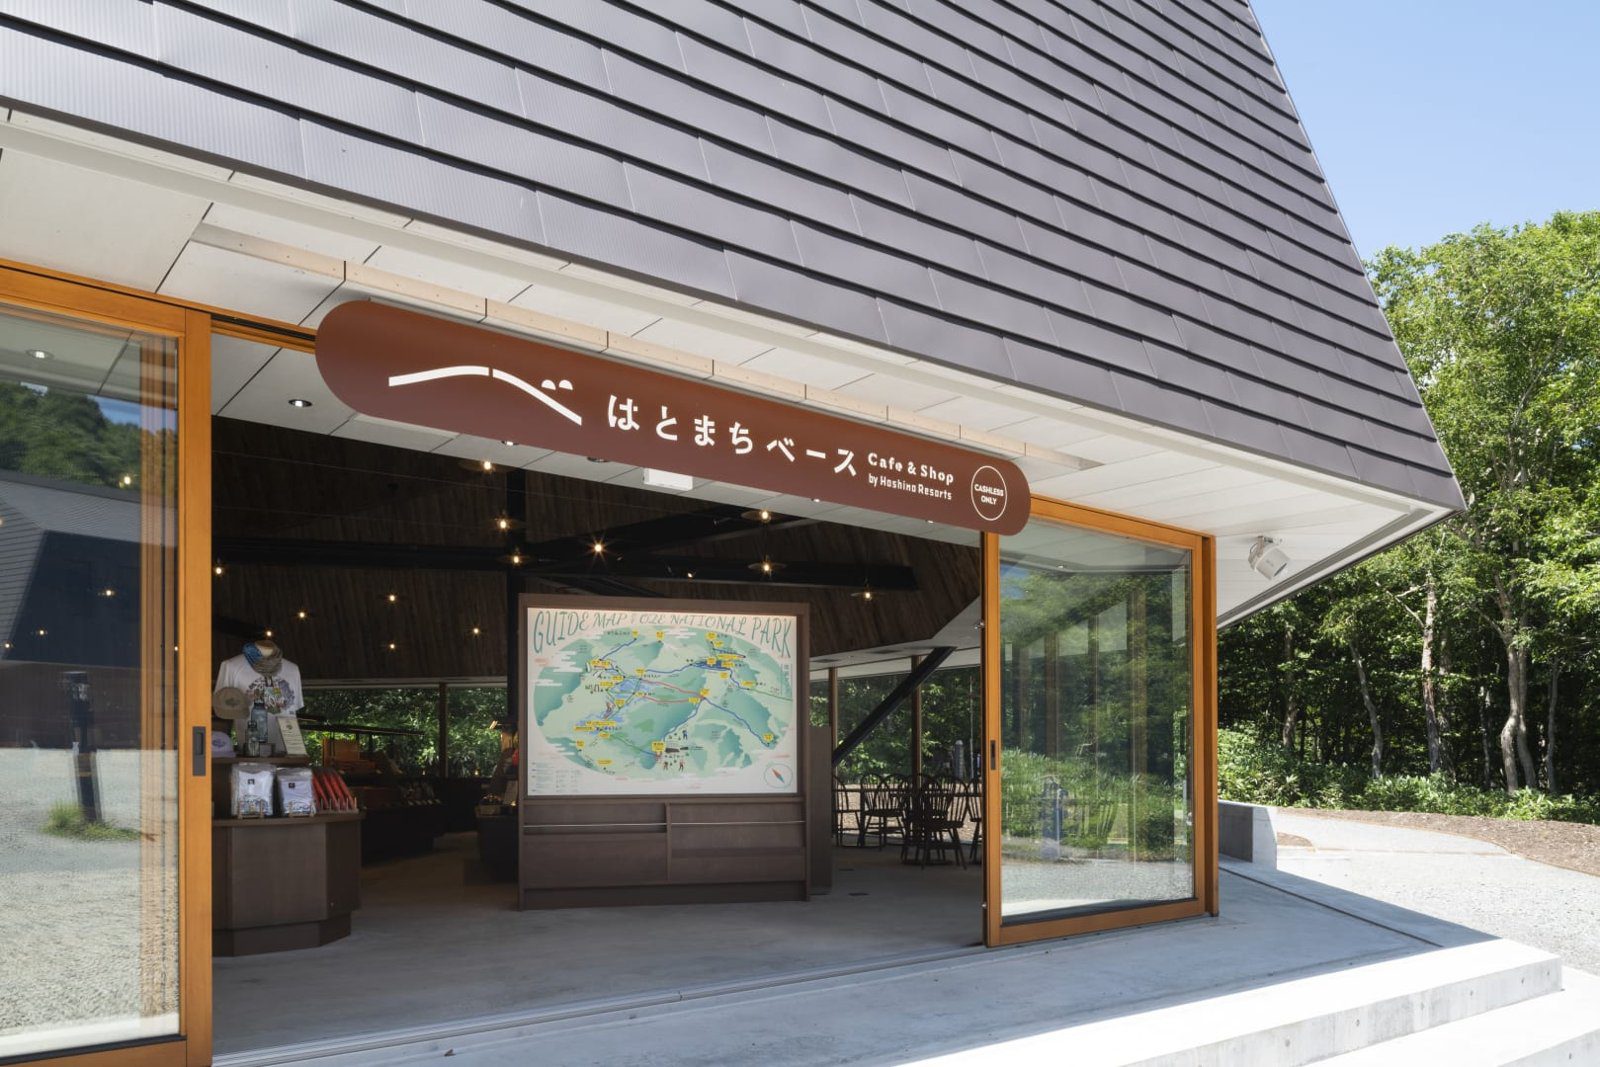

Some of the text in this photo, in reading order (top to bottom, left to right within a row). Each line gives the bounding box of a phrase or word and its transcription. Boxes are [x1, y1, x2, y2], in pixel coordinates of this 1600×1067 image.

[607, 394, 857, 477] はとまちベース
[867, 452, 954, 486] Cafe & Shop
[868, 473, 952, 500] by Hoshino Resorts
[974, 483, 1004, 497] CASHLESS
[980, 495, 998, 505] ONLY
[533, 610, 590, 654] GUIDE
[592, 612, 628, 629] MAP
[671, 615, 747, 636] NATIONAL
[752, 617, 793, 659] PARK
